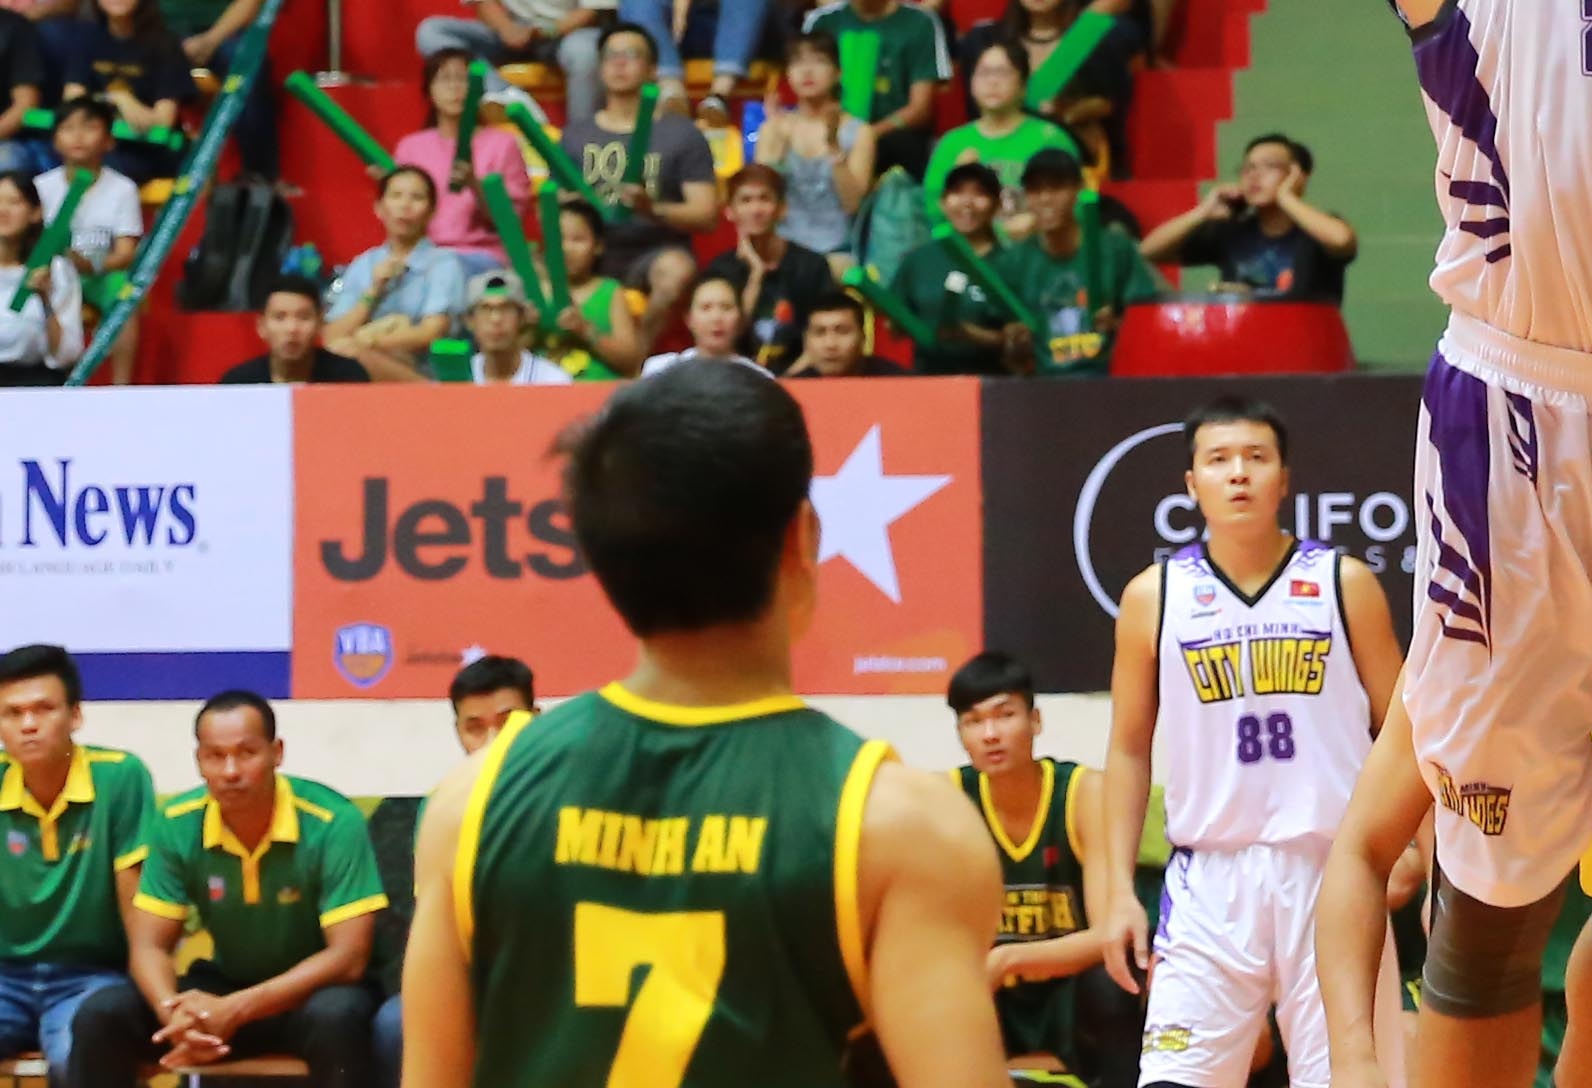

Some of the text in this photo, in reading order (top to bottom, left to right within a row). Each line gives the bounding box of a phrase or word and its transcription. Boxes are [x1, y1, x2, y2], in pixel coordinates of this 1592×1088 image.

[18, 458, 197, 547] News
[319, 476, 592, 582] Jets
[1153, 492, 1410, 544] CIFO
[1181, 637, 1332, 704] CITY WINGS
[1236, 712, 1296, 763] 88
[555, 806, 769, 876] MINH AN
[574, 901, 727, 1088] 7
